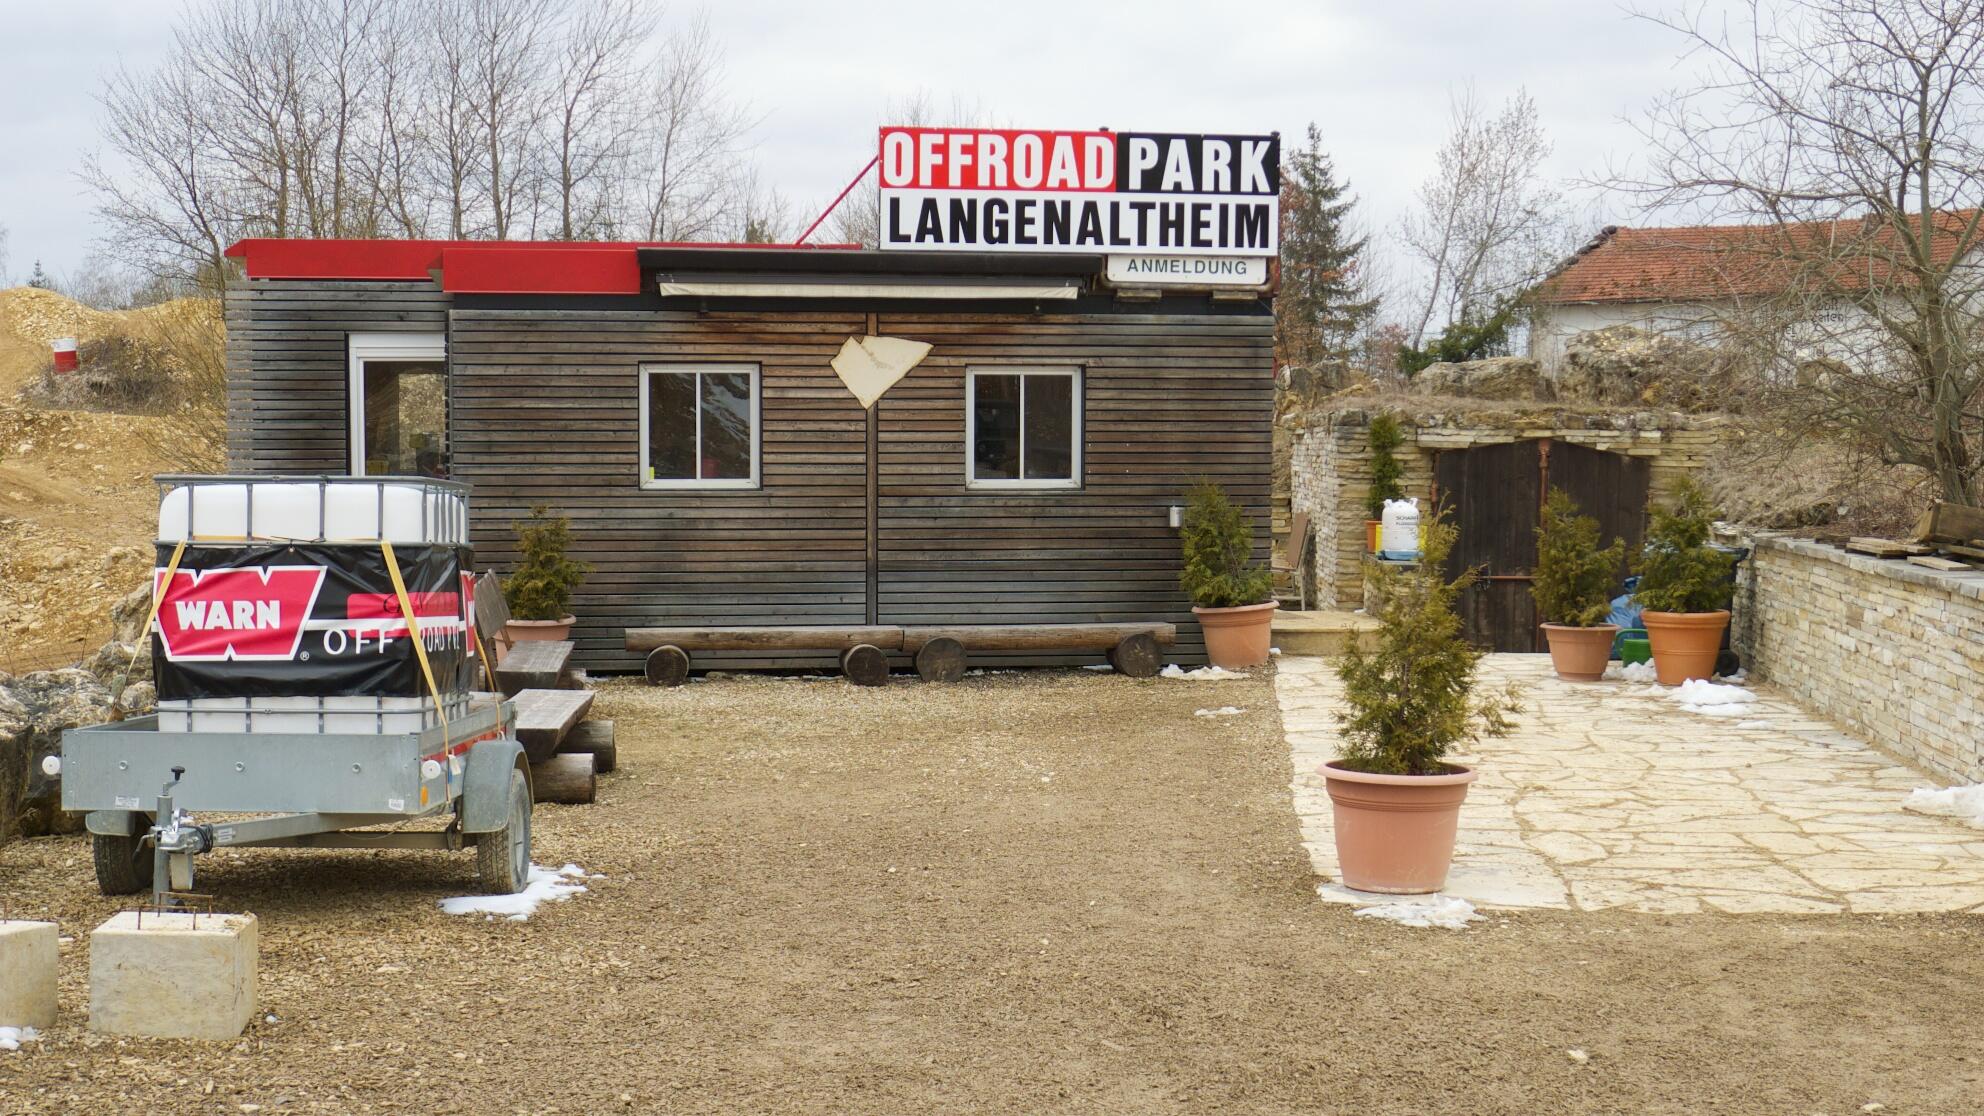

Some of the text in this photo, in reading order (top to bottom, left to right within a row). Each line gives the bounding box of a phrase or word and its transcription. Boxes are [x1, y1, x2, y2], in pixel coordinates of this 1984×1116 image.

[883, 131, 1272, 193] OFFROAD PARK
[889, 196, 1270, 250] LANGENALTHEIM
[1127, 257, 1248, 275] ANMELDUNG
[175, 599, 281, 631] WARN
[323, 627, 394, 655] OFF
